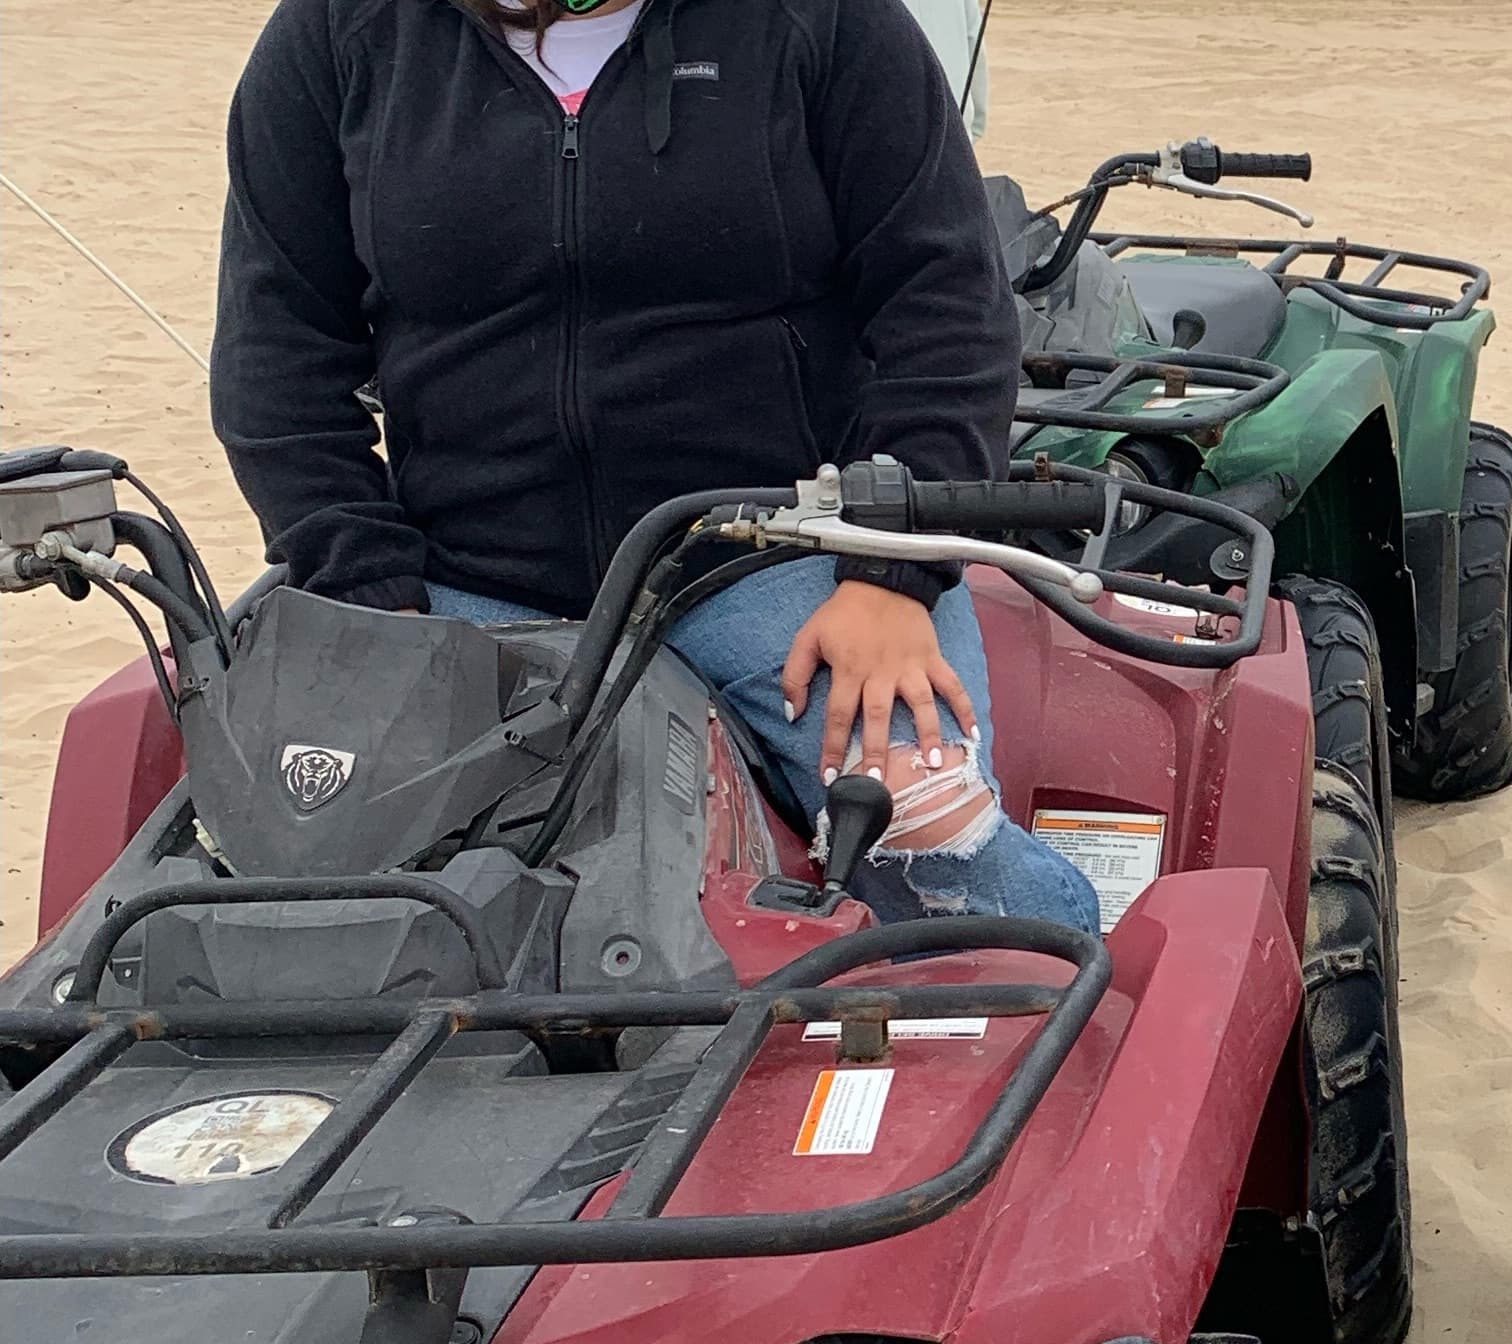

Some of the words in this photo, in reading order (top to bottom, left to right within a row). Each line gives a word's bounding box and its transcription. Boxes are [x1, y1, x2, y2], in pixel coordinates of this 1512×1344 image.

[673, 64, 715, 76] olumbia
[663, 718, 697, 805] YAMAHA
[216, 1099, 269, 1115] QL
